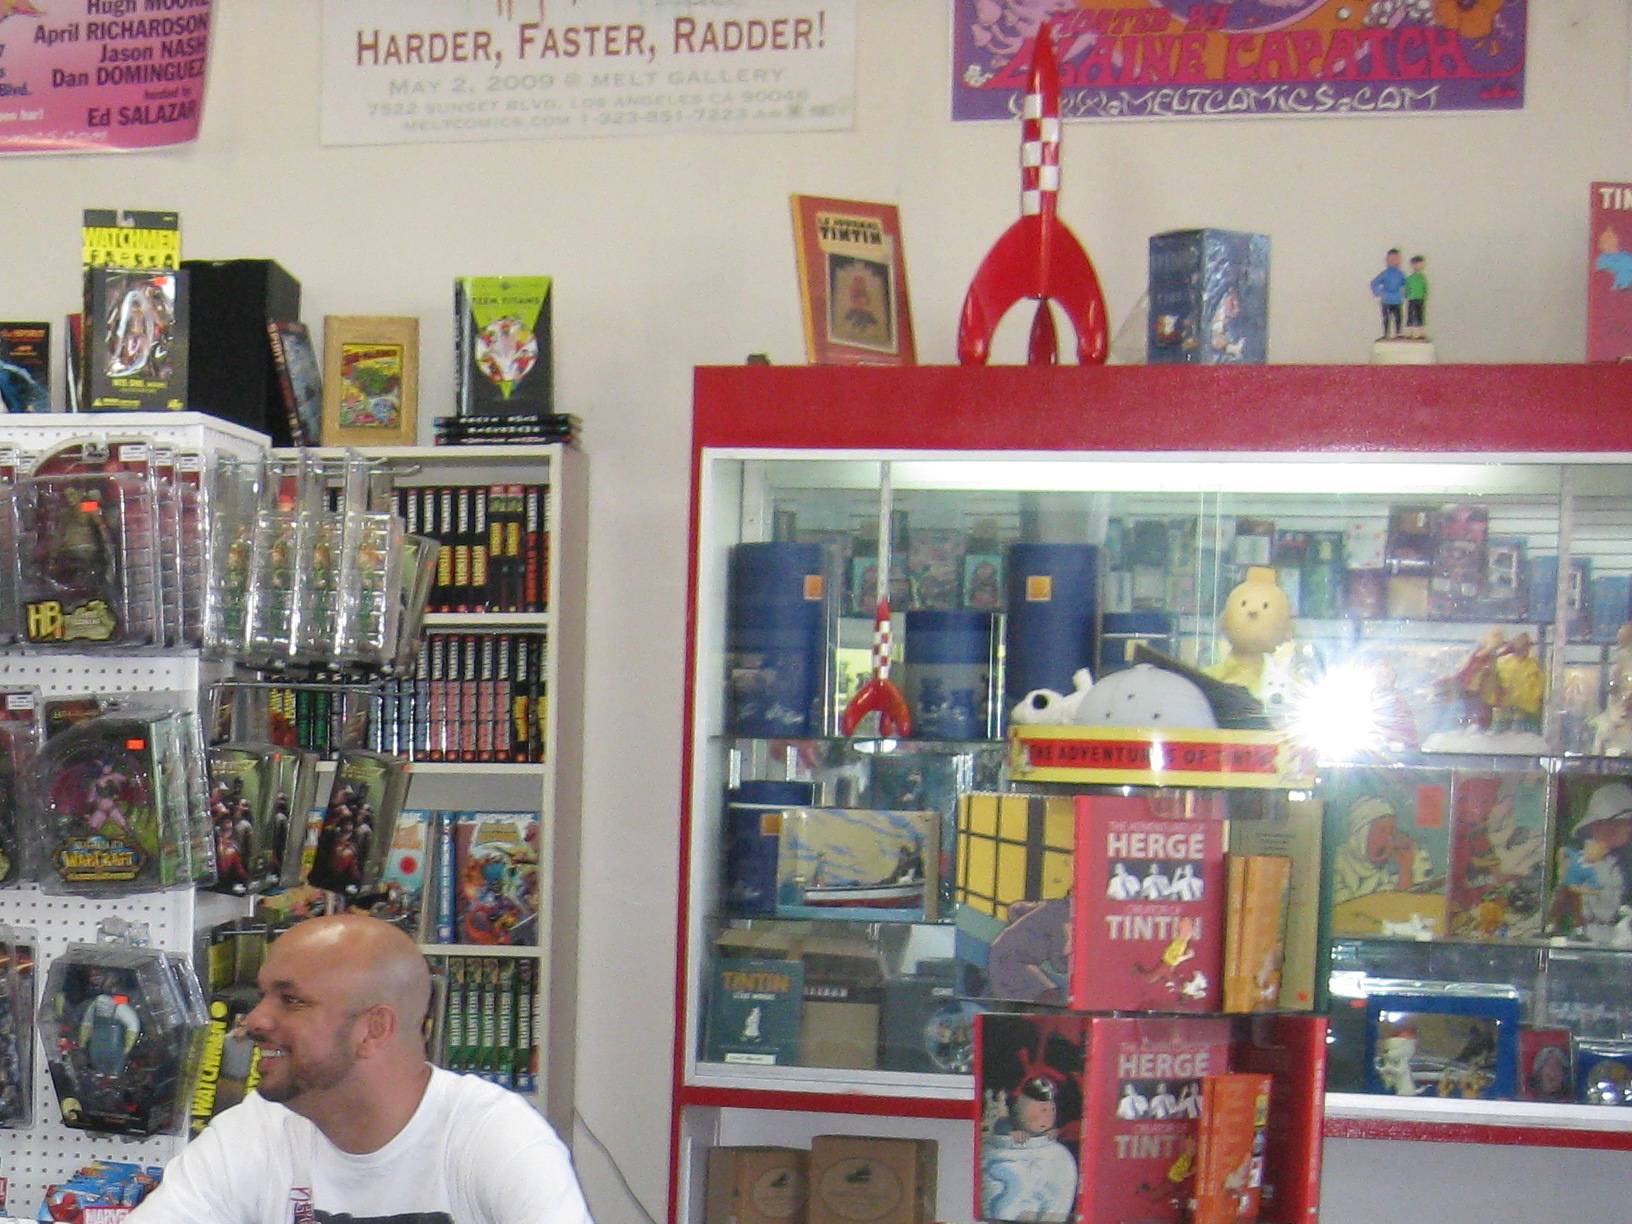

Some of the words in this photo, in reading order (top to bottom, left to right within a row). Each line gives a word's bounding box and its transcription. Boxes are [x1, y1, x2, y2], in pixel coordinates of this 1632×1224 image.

[34, 24, 80, 46] April
[86, 13, 209, 41] RICHARDSON
[356, 30, 503, 68] HARDER,
[520, 23, 657, 64] FASTER,
[673, 11, 826, 54] RADDER!
[100, 44, 154, 63] Jason
[160, 36, 207, 58] NASH
[52, 68, 89, 88] Dan
[96, 58, 206, 86] DOMINGUEZ
[487, 74, 554, 92] 2009
[591, 71, 657, 88] MELT
[669, 68, 786, 86] GALLERY
[87, 107, 111, 128] Ed
[118, 100, 198, 127] SALAZAR
[84, 227, 181, 250] WATCHMEN
